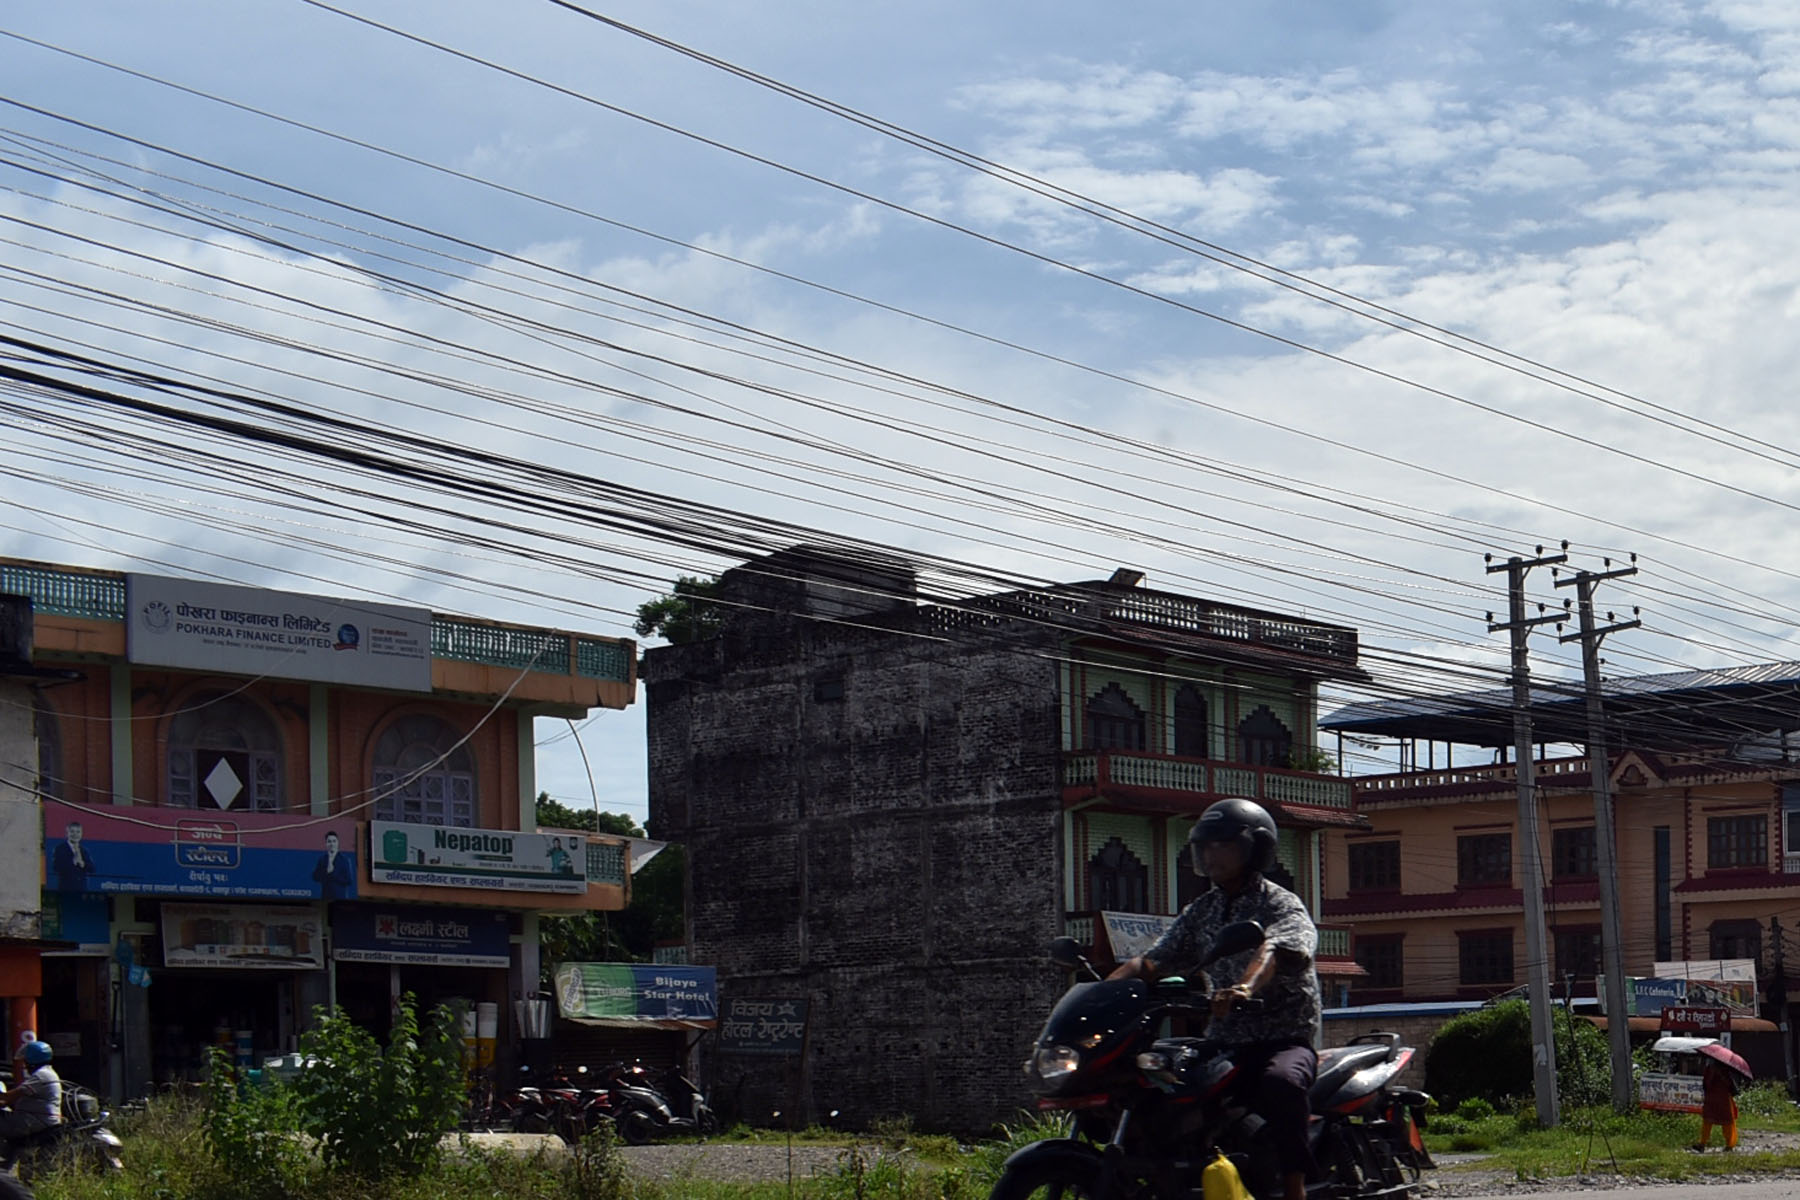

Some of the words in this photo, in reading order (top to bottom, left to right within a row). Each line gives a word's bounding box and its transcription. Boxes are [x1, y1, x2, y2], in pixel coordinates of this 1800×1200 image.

[176, 603, 216, 621] पोखरा
[221, 609, 279, 628] फाइनान्स
[283, 613, 331, 633] लिमिटेड
[176, 623, 233, 640] POKHARA
[236, 629, 284, 644] FINANCE
[288, 635, 331, 650] LIMITED
[434, 829, 513, 854] Nepatop
[438, 920, 469, 938] स्टील
[655, 977, 697, 989] Bijaya
[643, 990, 672, 1000] Star
[676, 991, 710, 1001] Hotel
[731, 999, 774, 1016] विजय
[721, 1017, 754, 1040] होटल
